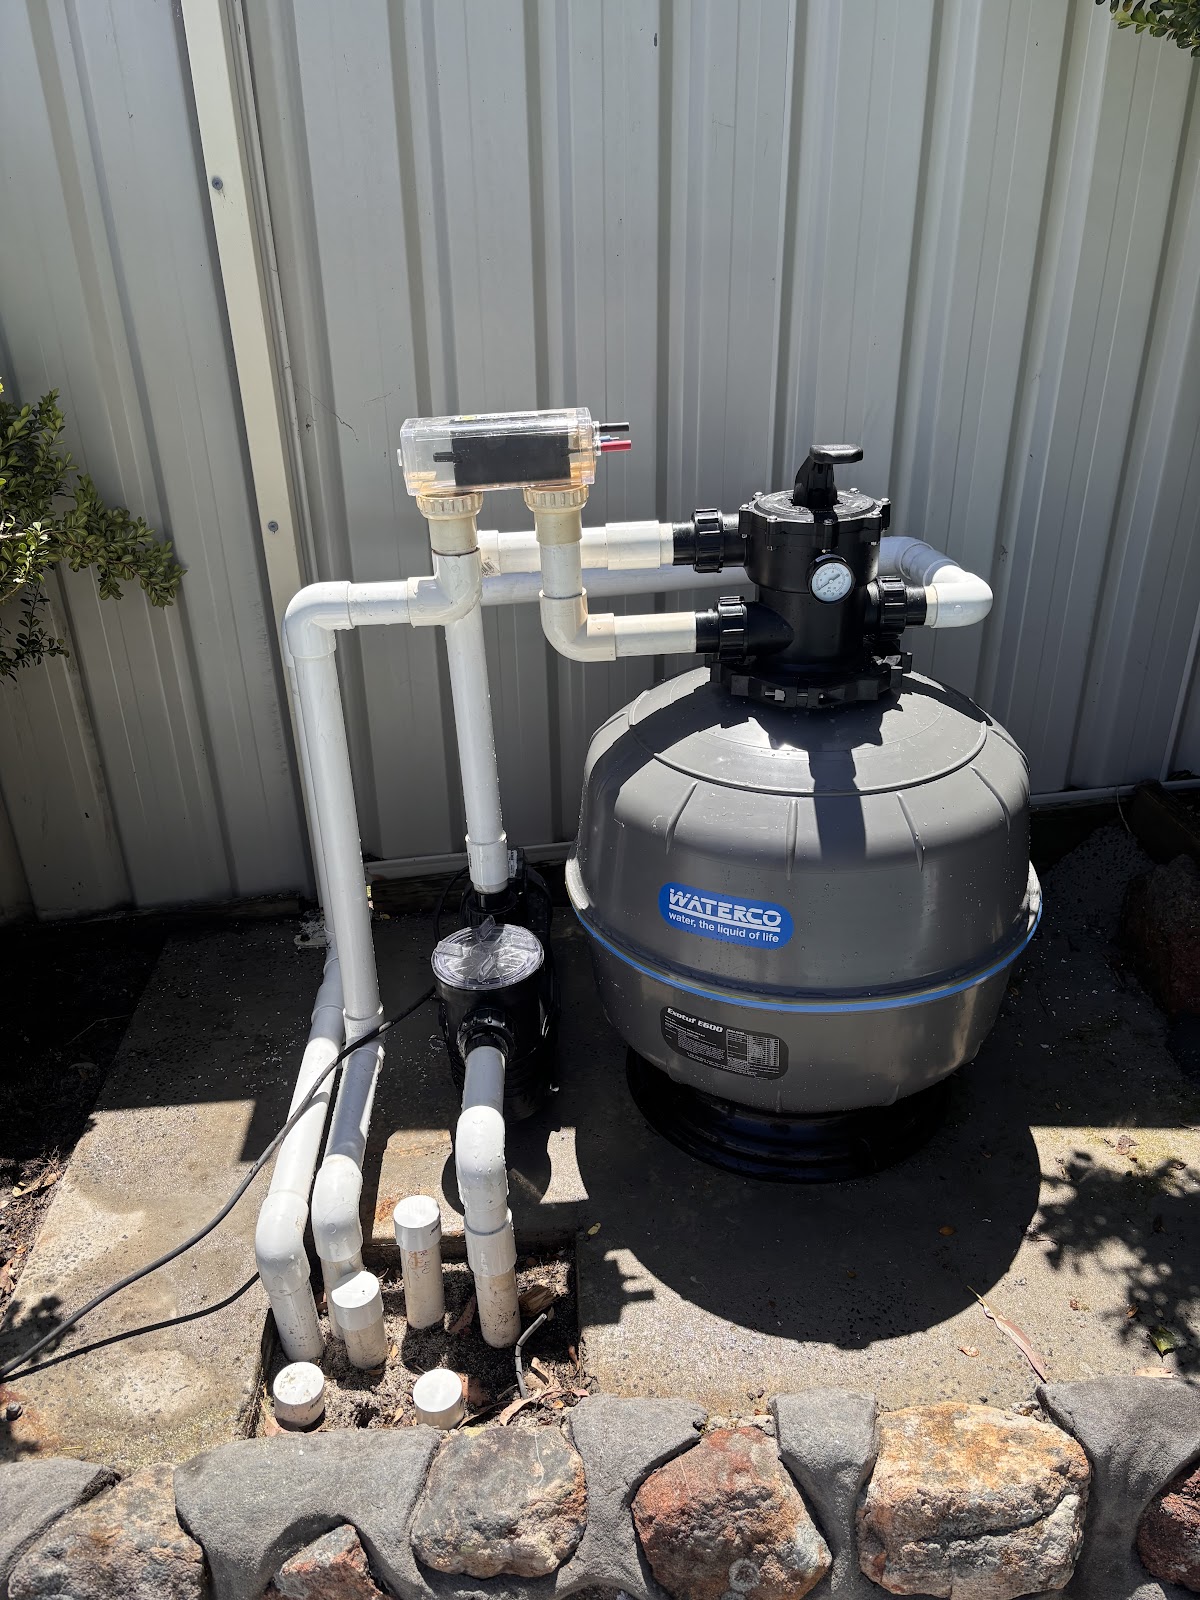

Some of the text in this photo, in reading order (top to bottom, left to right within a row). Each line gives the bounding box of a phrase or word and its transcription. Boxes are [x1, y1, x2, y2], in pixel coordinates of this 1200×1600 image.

[669, 888, 781, 927] WATERCO
[668, 911, 780, 943] water, the liquid of life
[667, 1007, 697, 1024] Exotuf
[697, 1020, 724, 1033] E600
